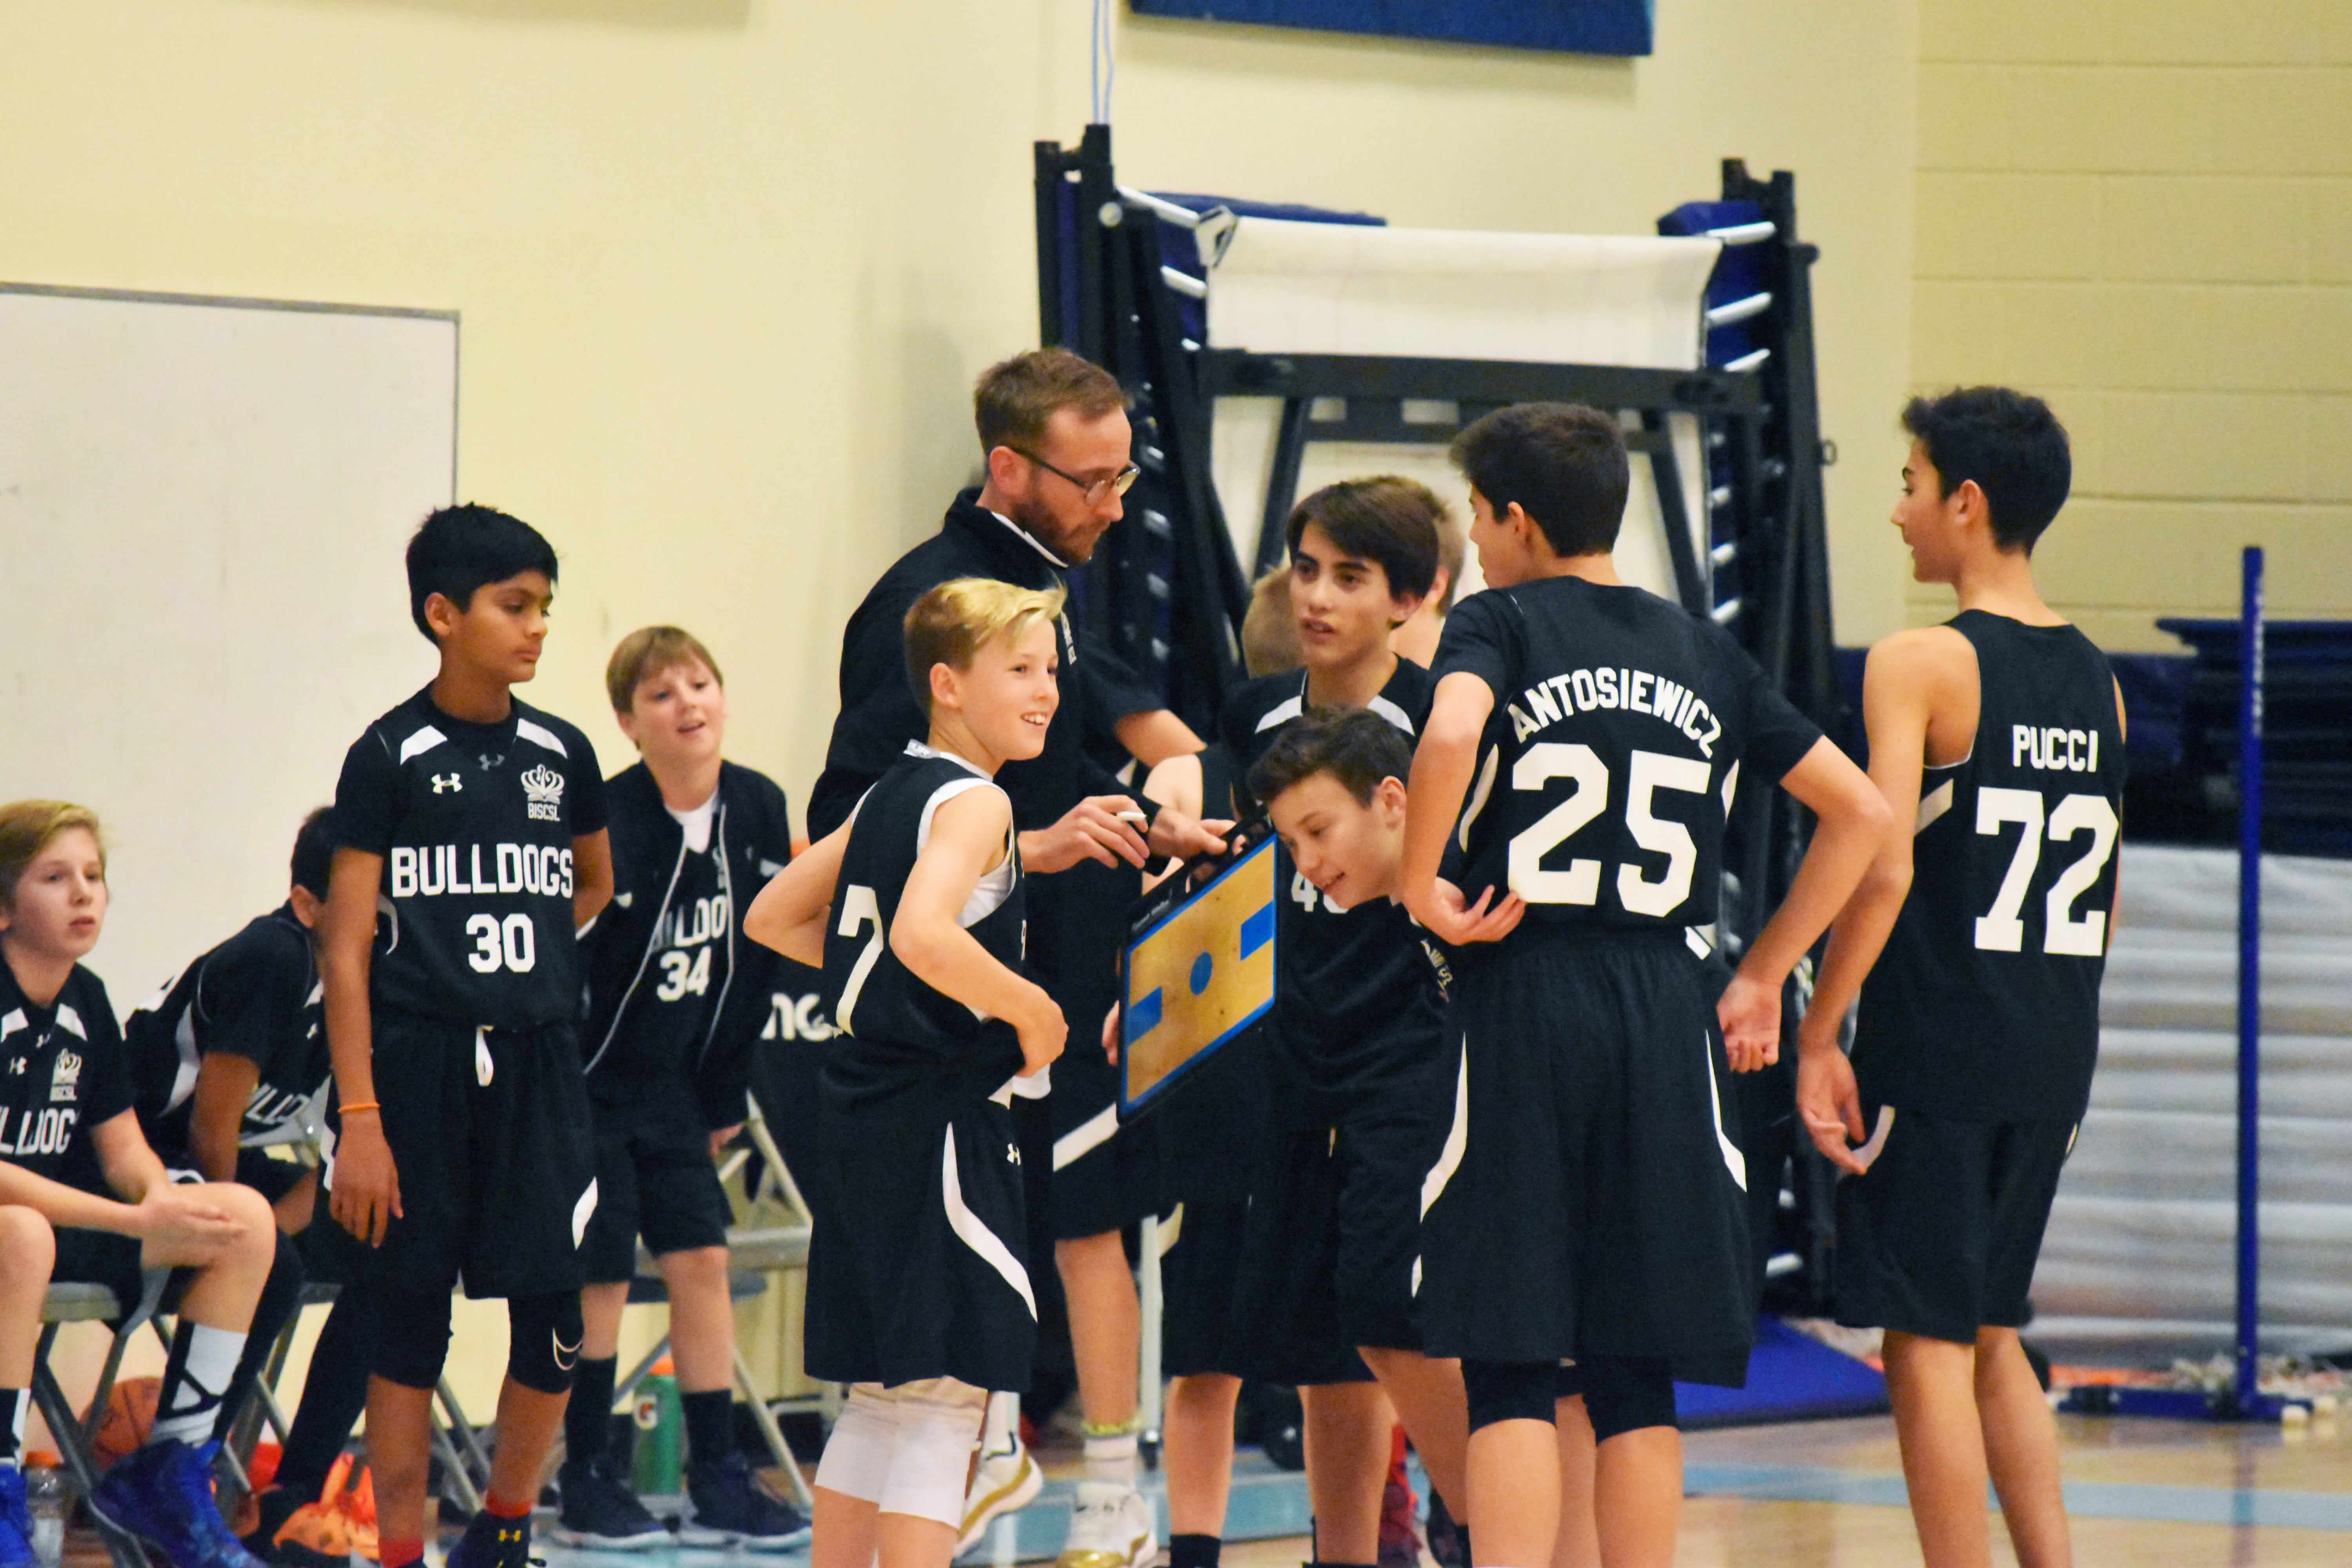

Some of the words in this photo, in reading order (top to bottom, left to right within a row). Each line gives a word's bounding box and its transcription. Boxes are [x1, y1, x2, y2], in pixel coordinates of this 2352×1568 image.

[1508, 667, 1721, 759] ANTOSIEWICZ
[2012, 724, 2099, 773] PUCCI
[1508, 742, 1711, 918] 25
[392, 843, 573, 898] BULLDOGS
[1291, 871, 1349, 914] 4
[1975, 786, 2119, 956] 72
[465, 913, 535, 973] 30
[657, 945, 711, 1002] 34
